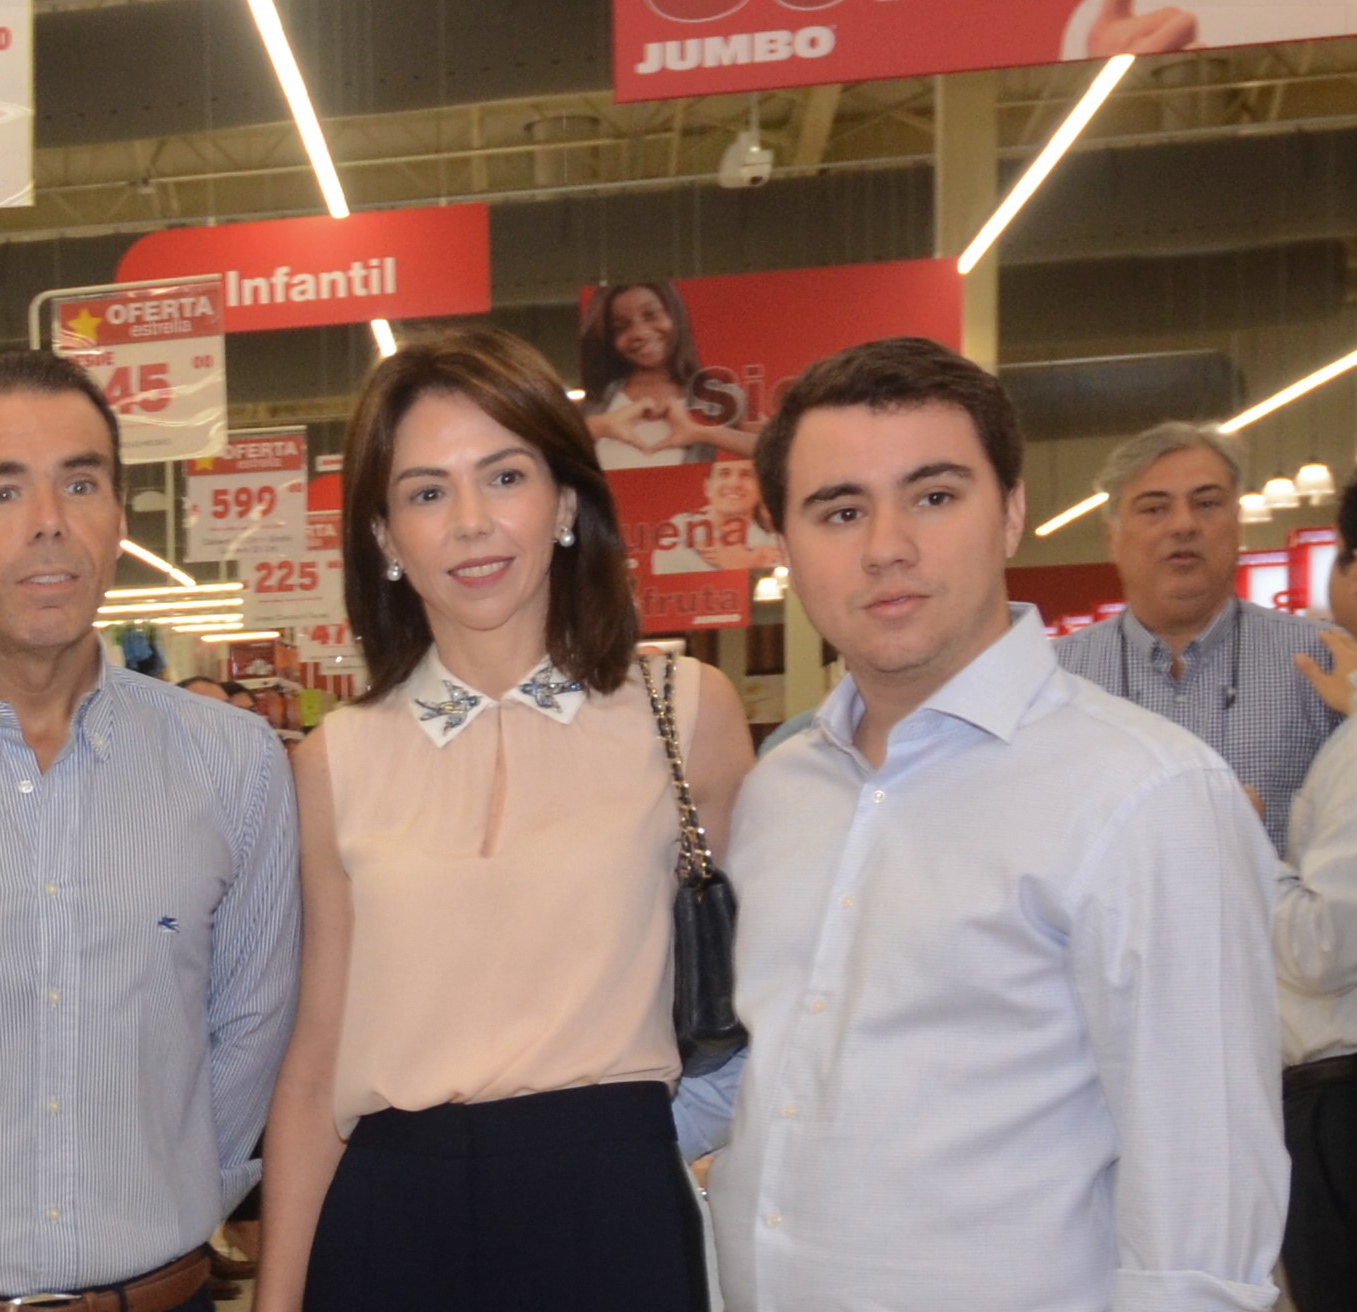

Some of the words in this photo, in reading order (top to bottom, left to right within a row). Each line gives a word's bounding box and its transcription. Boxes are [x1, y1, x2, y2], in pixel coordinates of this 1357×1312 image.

[635, 26, 835, 74] JUMBO
[225, 257, 396, 307] Infantil
[105, 296, 215, 325] OFERTA
[129, 319, 193, 337] estrella
[192, 355, 214, 369] 00
[211, 485, 277, 519] 599
[254, 560, 319, 593] 225
